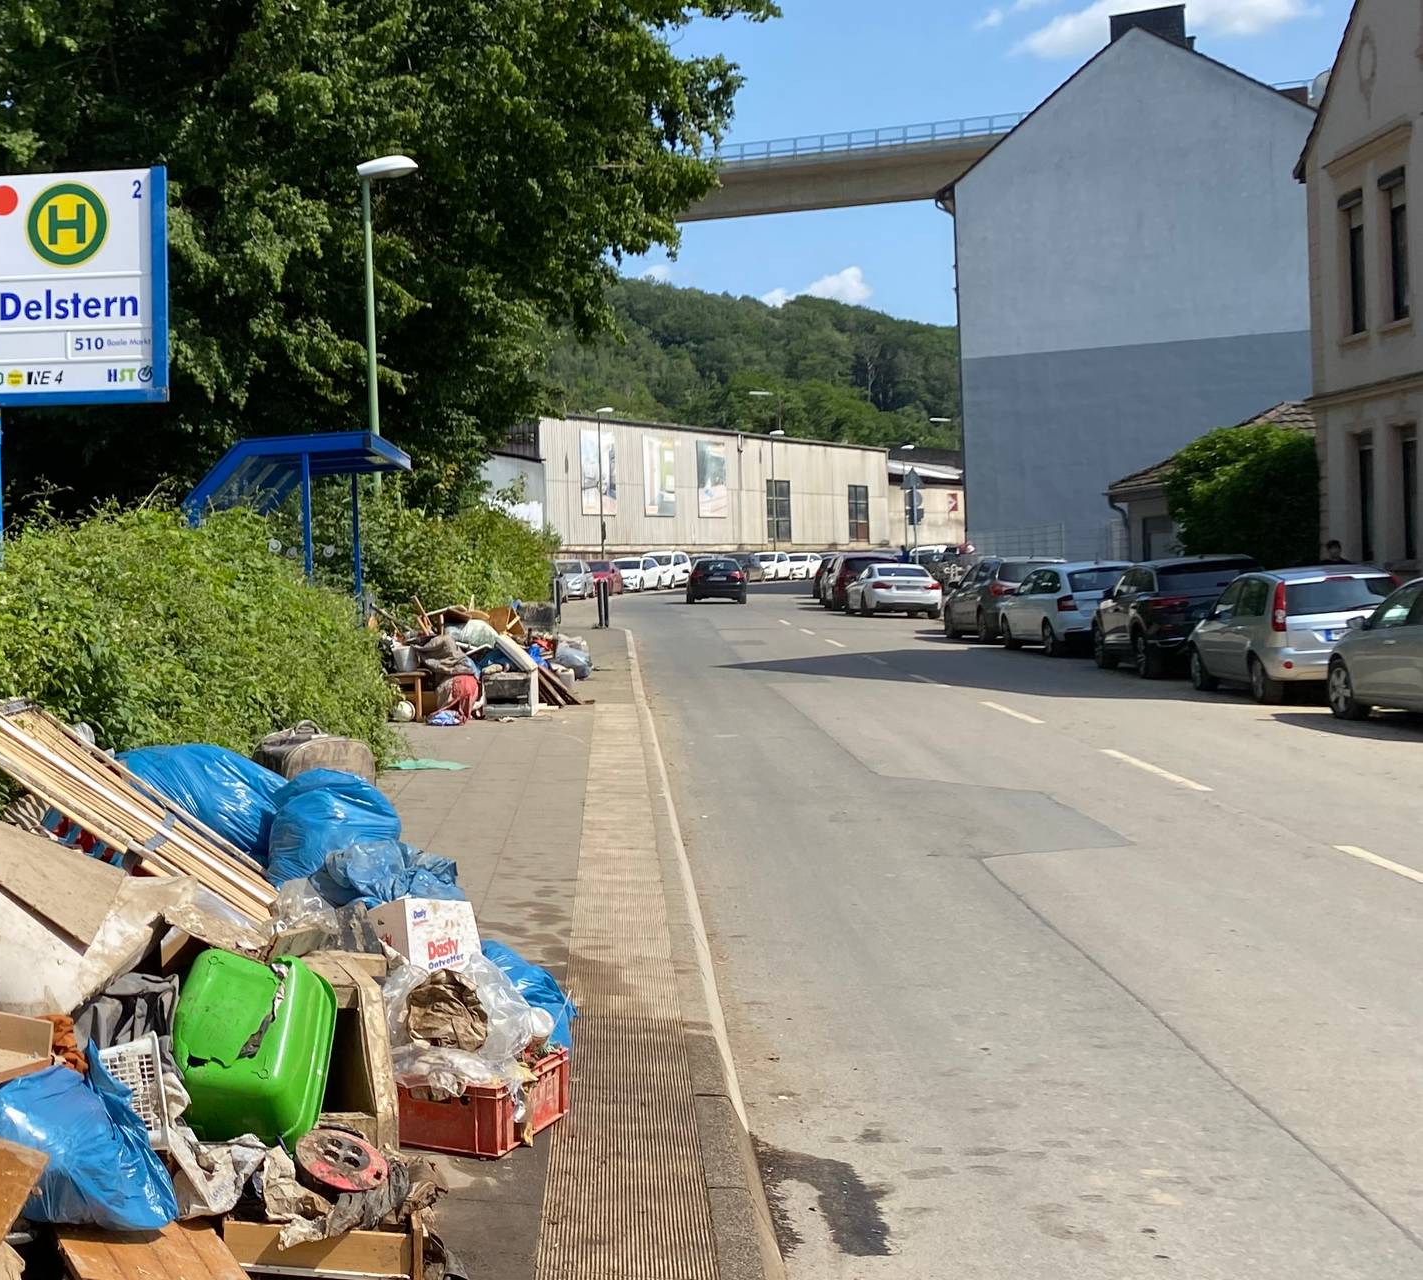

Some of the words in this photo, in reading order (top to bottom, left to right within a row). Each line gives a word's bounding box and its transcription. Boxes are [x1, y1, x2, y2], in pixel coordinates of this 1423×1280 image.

[132, 180, 142, 199] 2
[47, 203, 87, 246] H
[0, 289, 139, 321] Delstern
[74, 337, 104, 351] 510
[54, 369, 64, 385] 4
[107, 368, 137, 383] HST
[427, 937, 459, 961] Dasty
